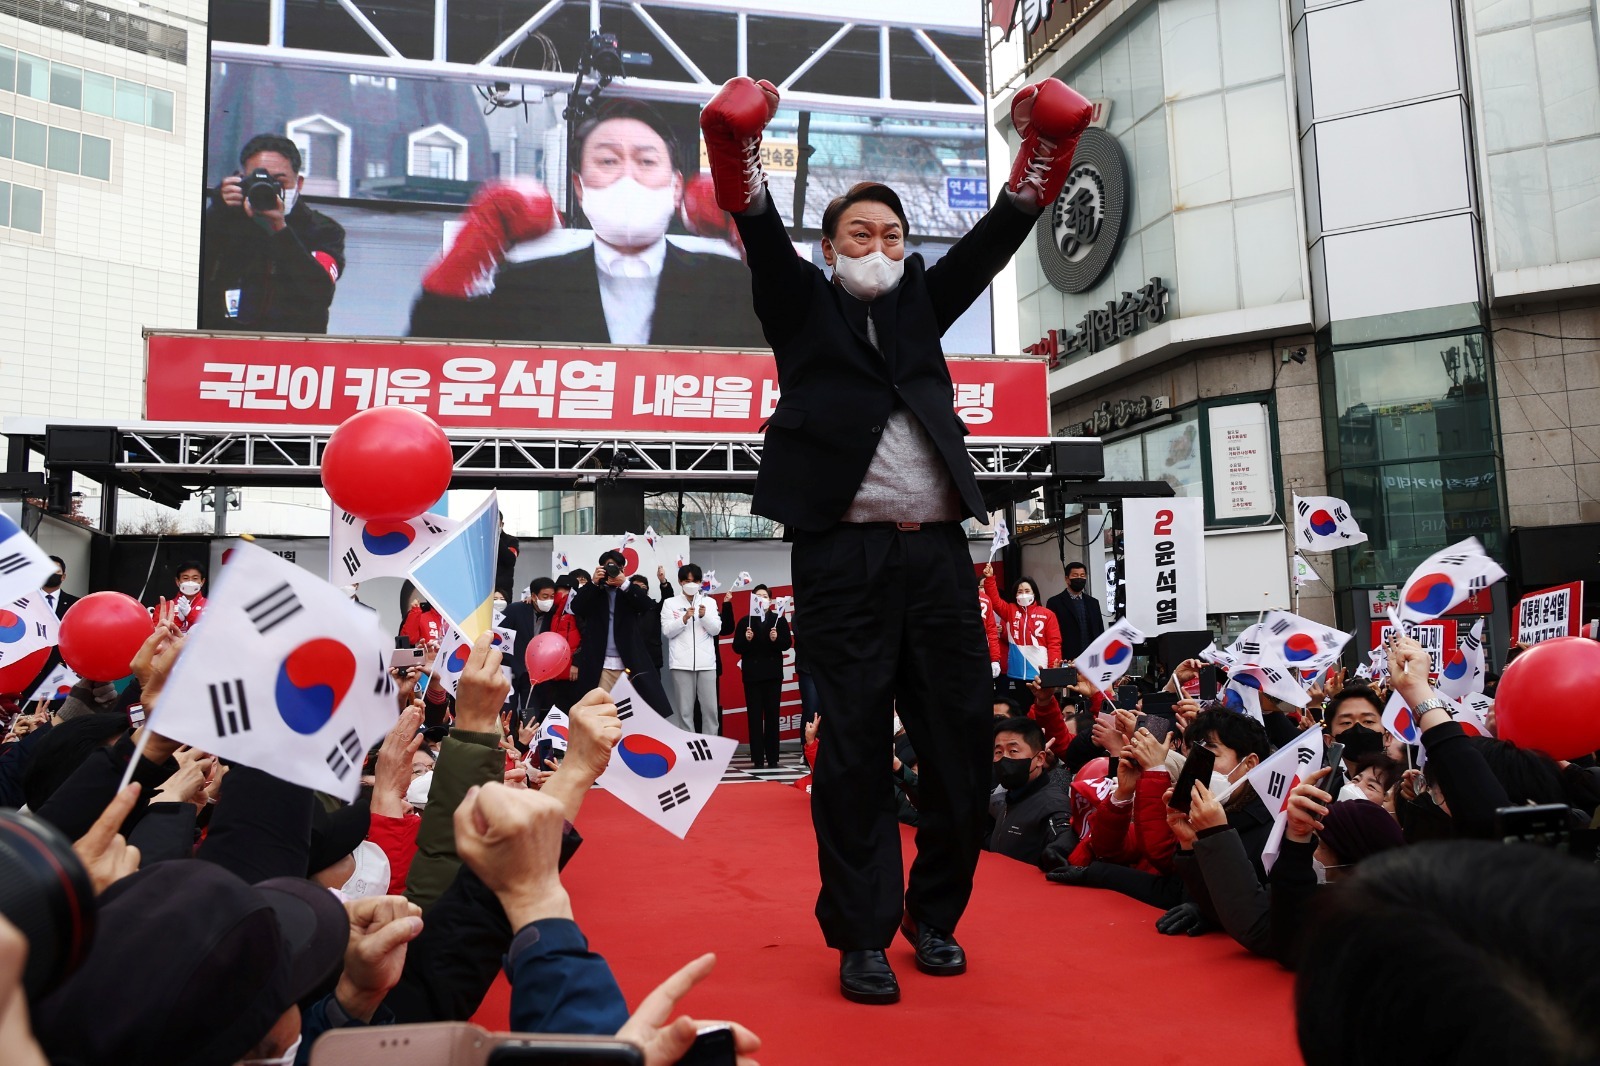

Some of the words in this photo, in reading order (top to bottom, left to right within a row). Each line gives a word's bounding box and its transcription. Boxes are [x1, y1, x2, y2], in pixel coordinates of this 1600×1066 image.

[200, 362, 336, 410] 국민이
[344, 367, 430, 413] 키운
[438, 357, 617, 419] 윤석열
[632, 374, 753, 419] 내일을
[952, 382, 995, 425] 령
[1154, 509, 1174, 535] 2
[1155, 541, 1177, 625] 윤석열
[1521, 597, 1543, 628] 대통령!
[1543, 592, 1568, 624] 윤석열!
[1034, 620, 1045, 638] 2
[779, 715, 802, 732] 일을
